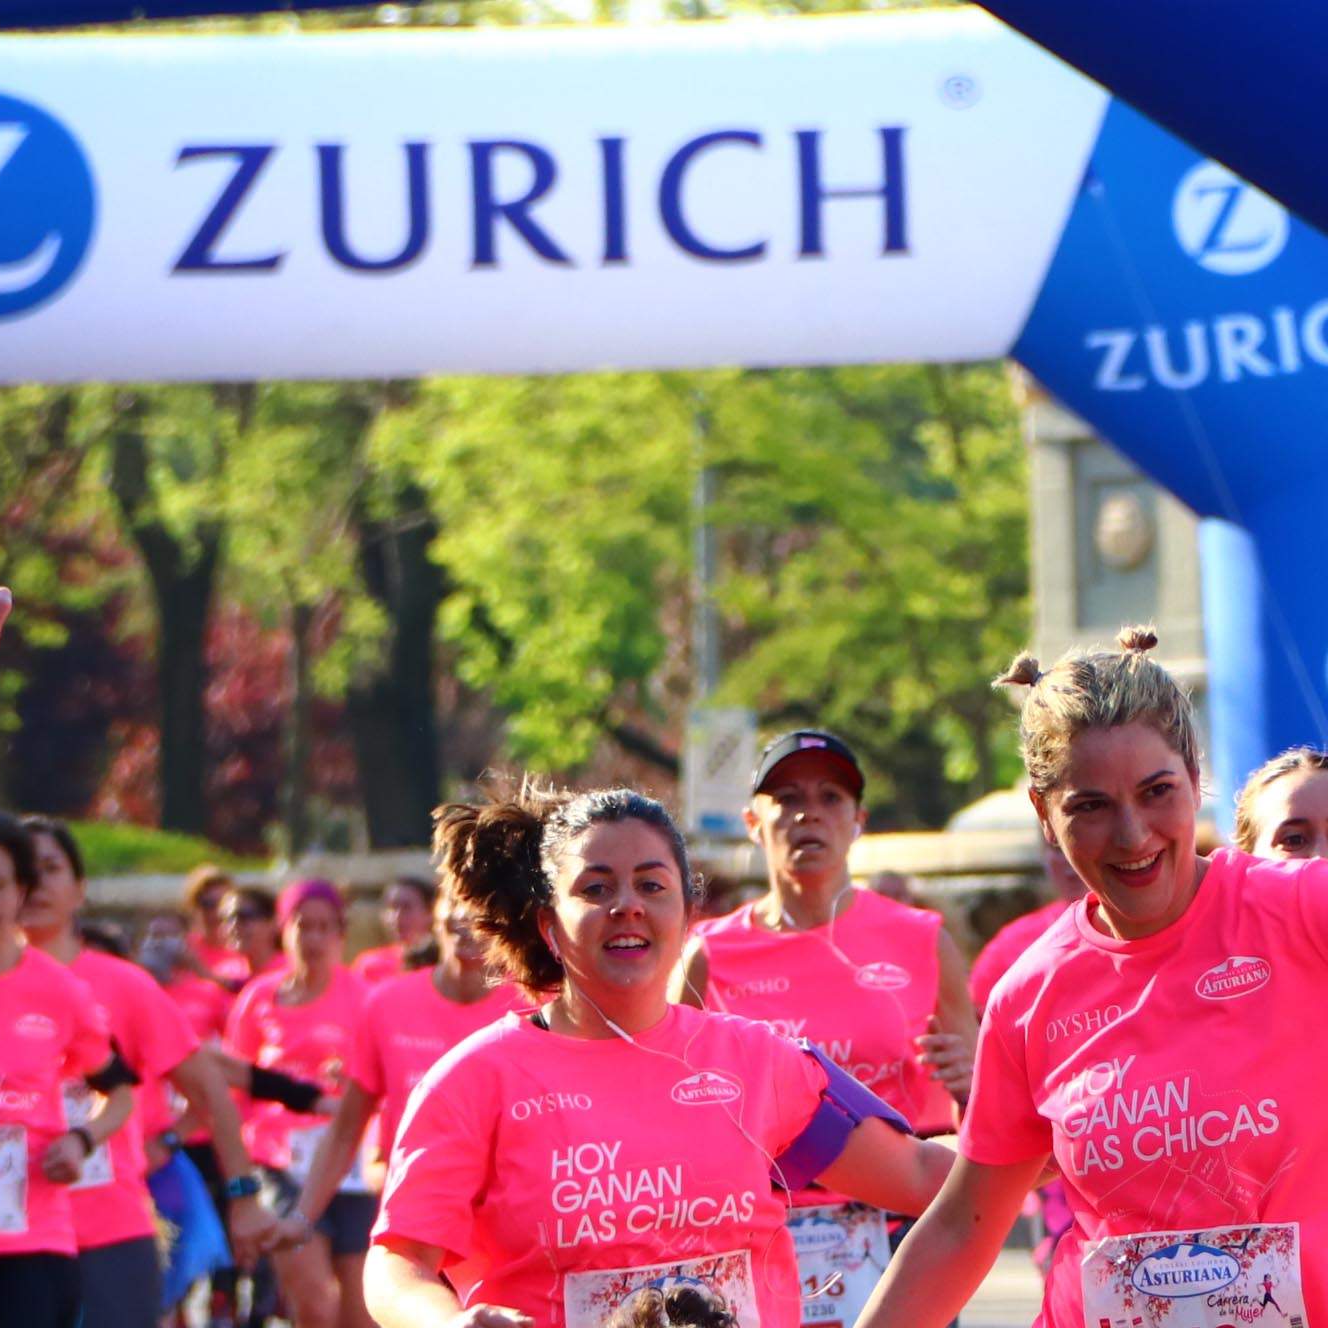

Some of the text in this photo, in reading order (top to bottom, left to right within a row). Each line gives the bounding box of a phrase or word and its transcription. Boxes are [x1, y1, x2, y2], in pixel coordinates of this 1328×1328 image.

[169, 125, 914, 277] ZURICH
[1201, 967, 1268, 994] ASTURIANA
[771, 1018, 807, 1038] OY
[1046, 1004, 1122, 1043] OYSHO
[1064, 1055, 1136, 1102] HOY
[512, 1093, 592, 1120] OYSHO
[1062, 1077, 1190, 1138] GANAN
[1071, 1099, 1280, 1177] LAS CHICAS
[551, 1141, 622, 1180] HOY
[552, 1165, 682, 1213] GANAN
[557, 1191, 756, 1248] LAS CHICAS
[803, 1272, 845, 1298] 16
[1139, 1266, 1233, 1288] ASTURIANA
